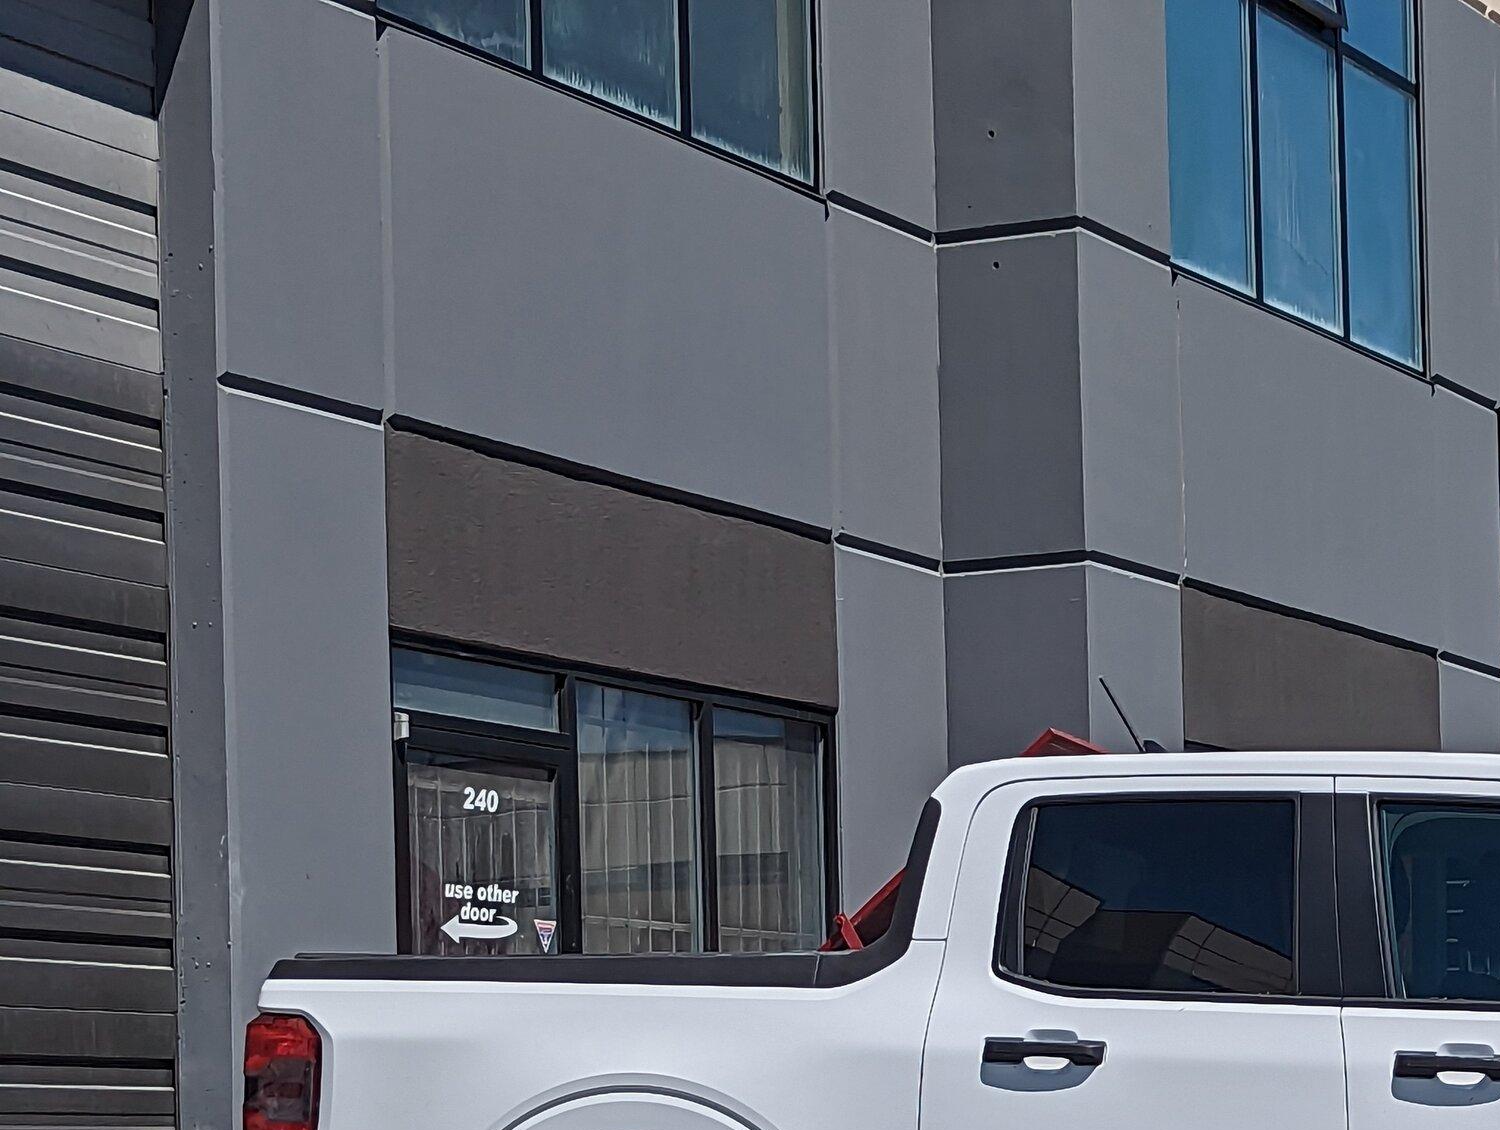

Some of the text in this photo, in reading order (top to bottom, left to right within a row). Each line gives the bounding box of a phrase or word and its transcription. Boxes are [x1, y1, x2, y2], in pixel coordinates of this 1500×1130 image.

[463, 787, 498, 812] 240
[444, 883, 519, 903] use other
[460, 902, 496, 921] door
